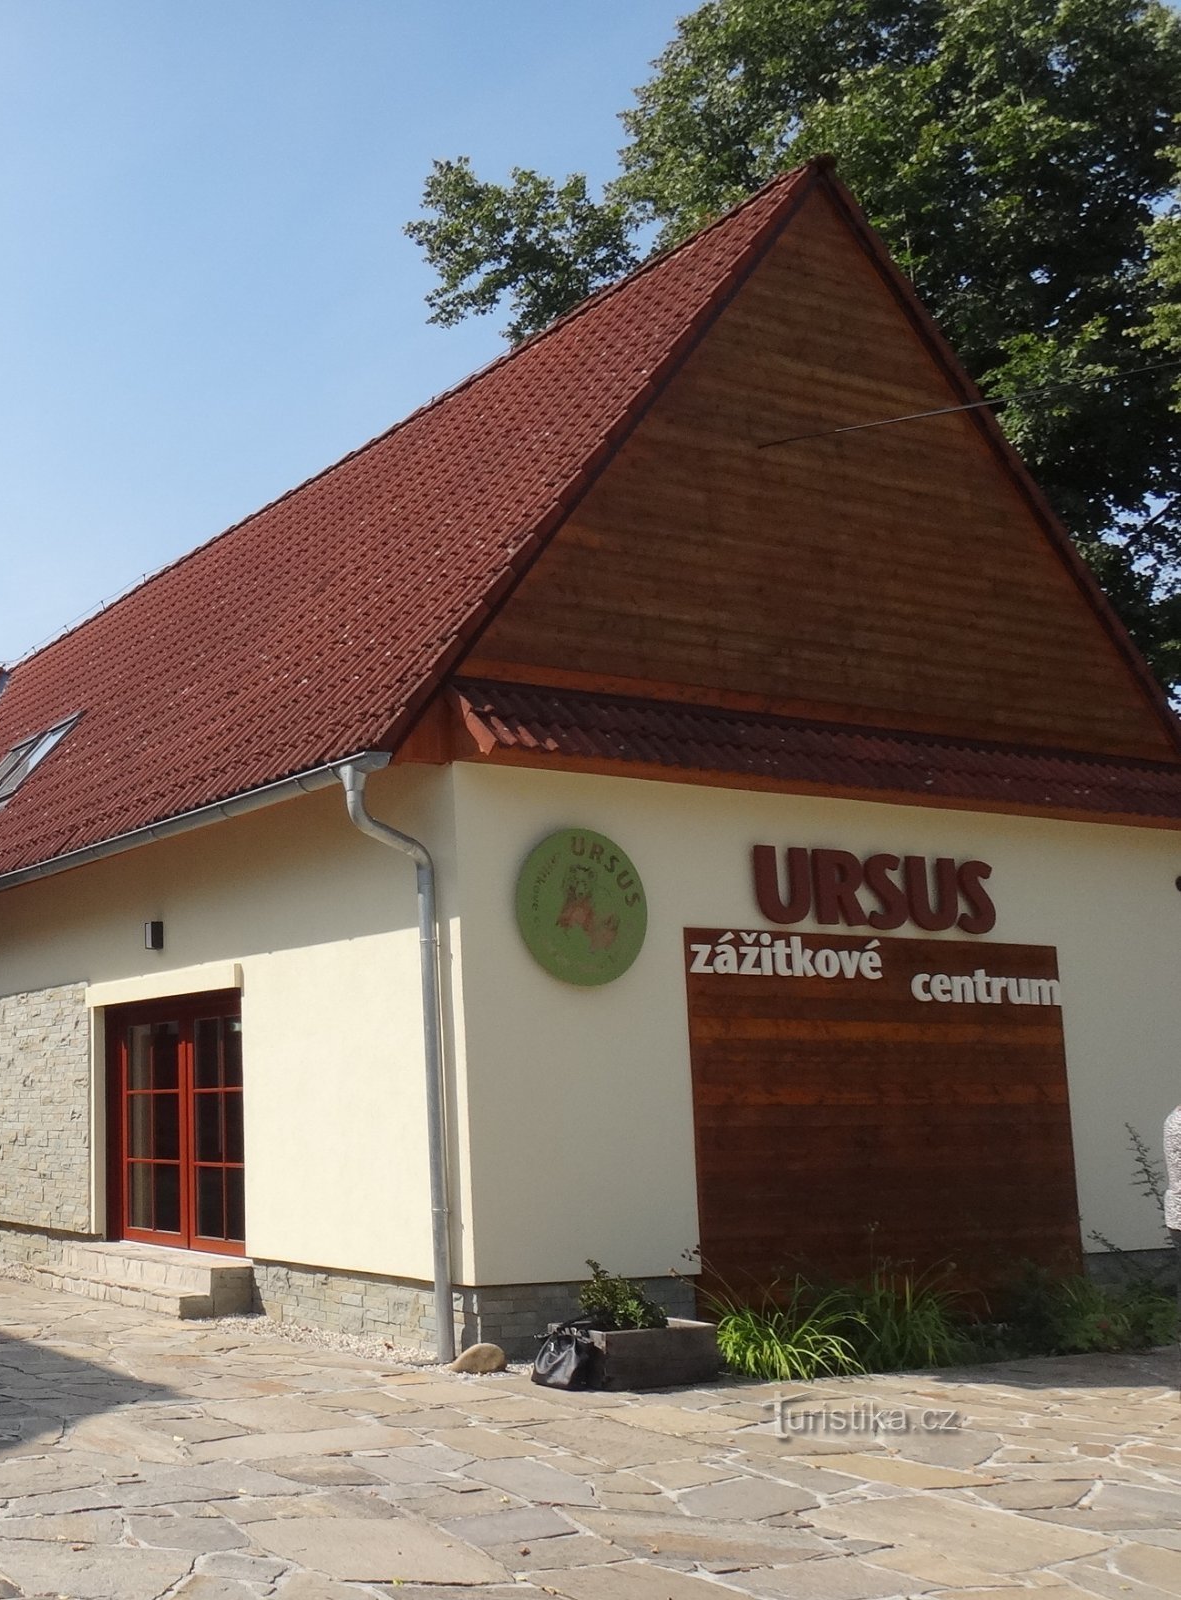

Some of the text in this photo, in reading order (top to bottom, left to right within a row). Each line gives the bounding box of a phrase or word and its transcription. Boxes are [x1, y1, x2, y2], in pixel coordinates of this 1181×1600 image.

[572, 837, 640, 906] URSUS
[754, 845, 996, 934] URSUS
[690, 930, 883, 980] zážitkové
[910, 968, 1061, 1006] centrum
